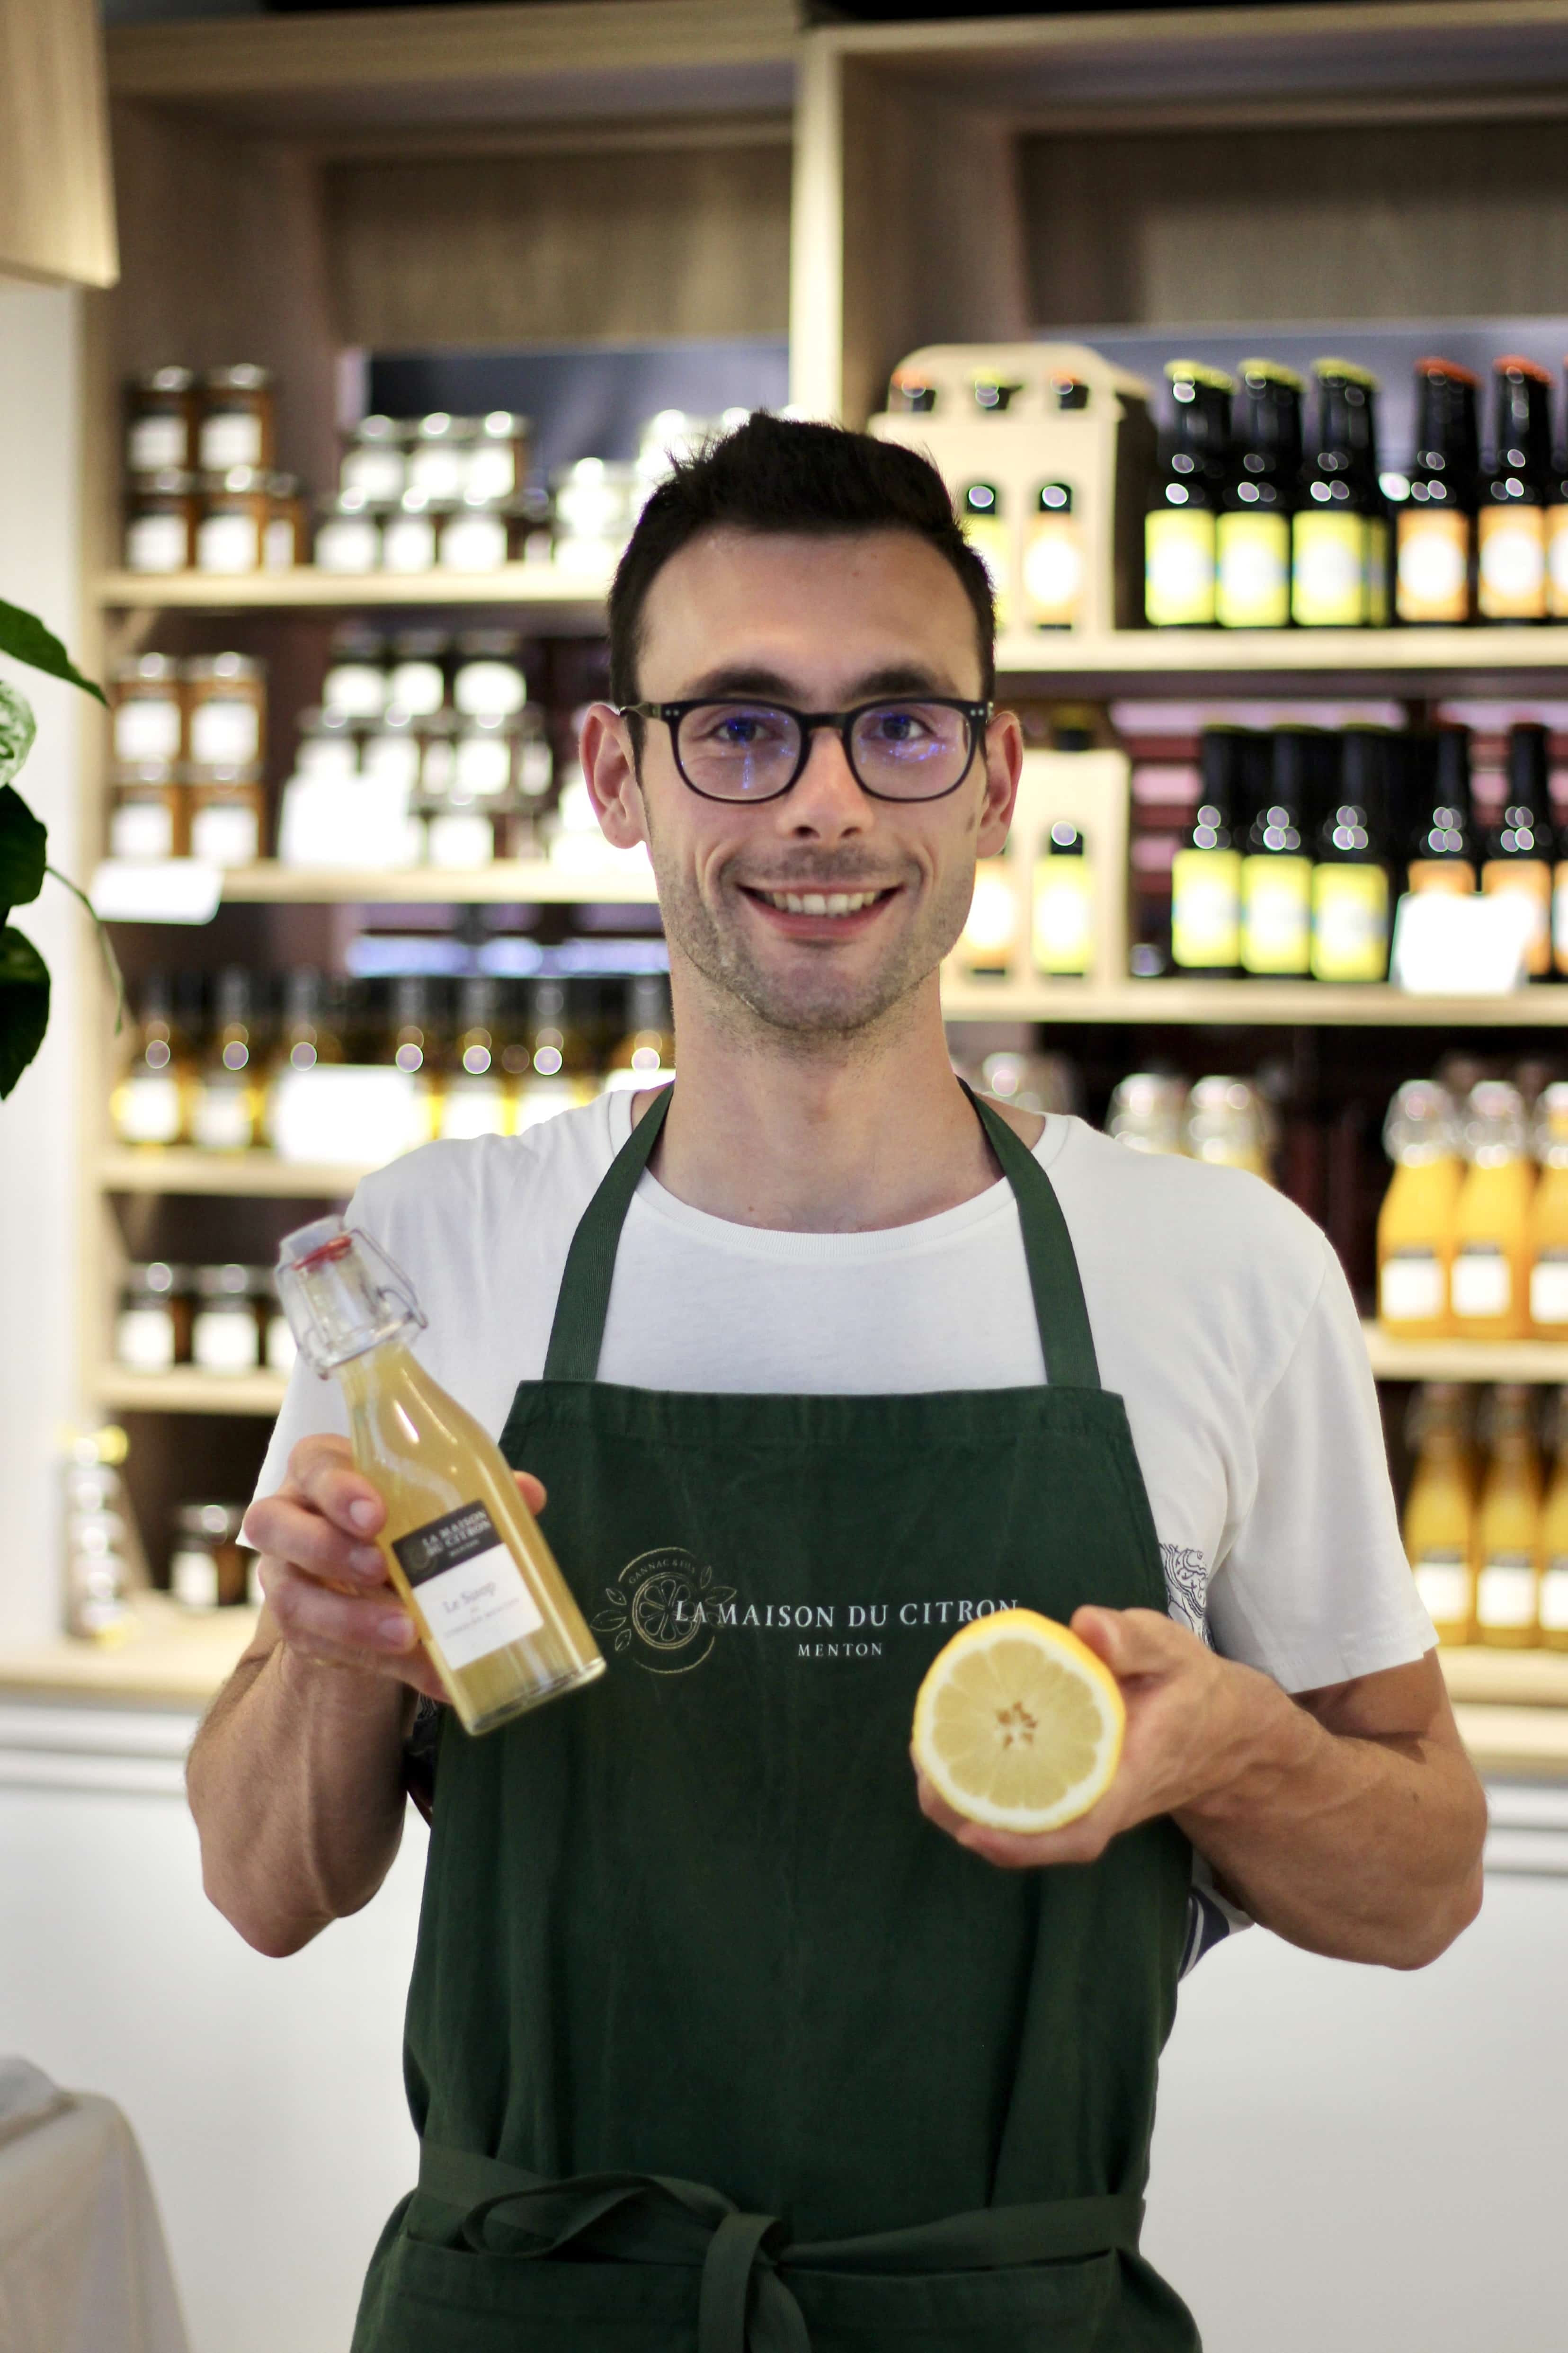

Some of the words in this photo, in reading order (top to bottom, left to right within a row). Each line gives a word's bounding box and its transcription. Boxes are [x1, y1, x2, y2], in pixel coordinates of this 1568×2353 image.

[676, 1600, 707, 1622] LA
[718, 1603, 835, 1627] MAISON
[848, 1604, 889, 1627] DU
[798, 1643, 882, 1657] MENTON
